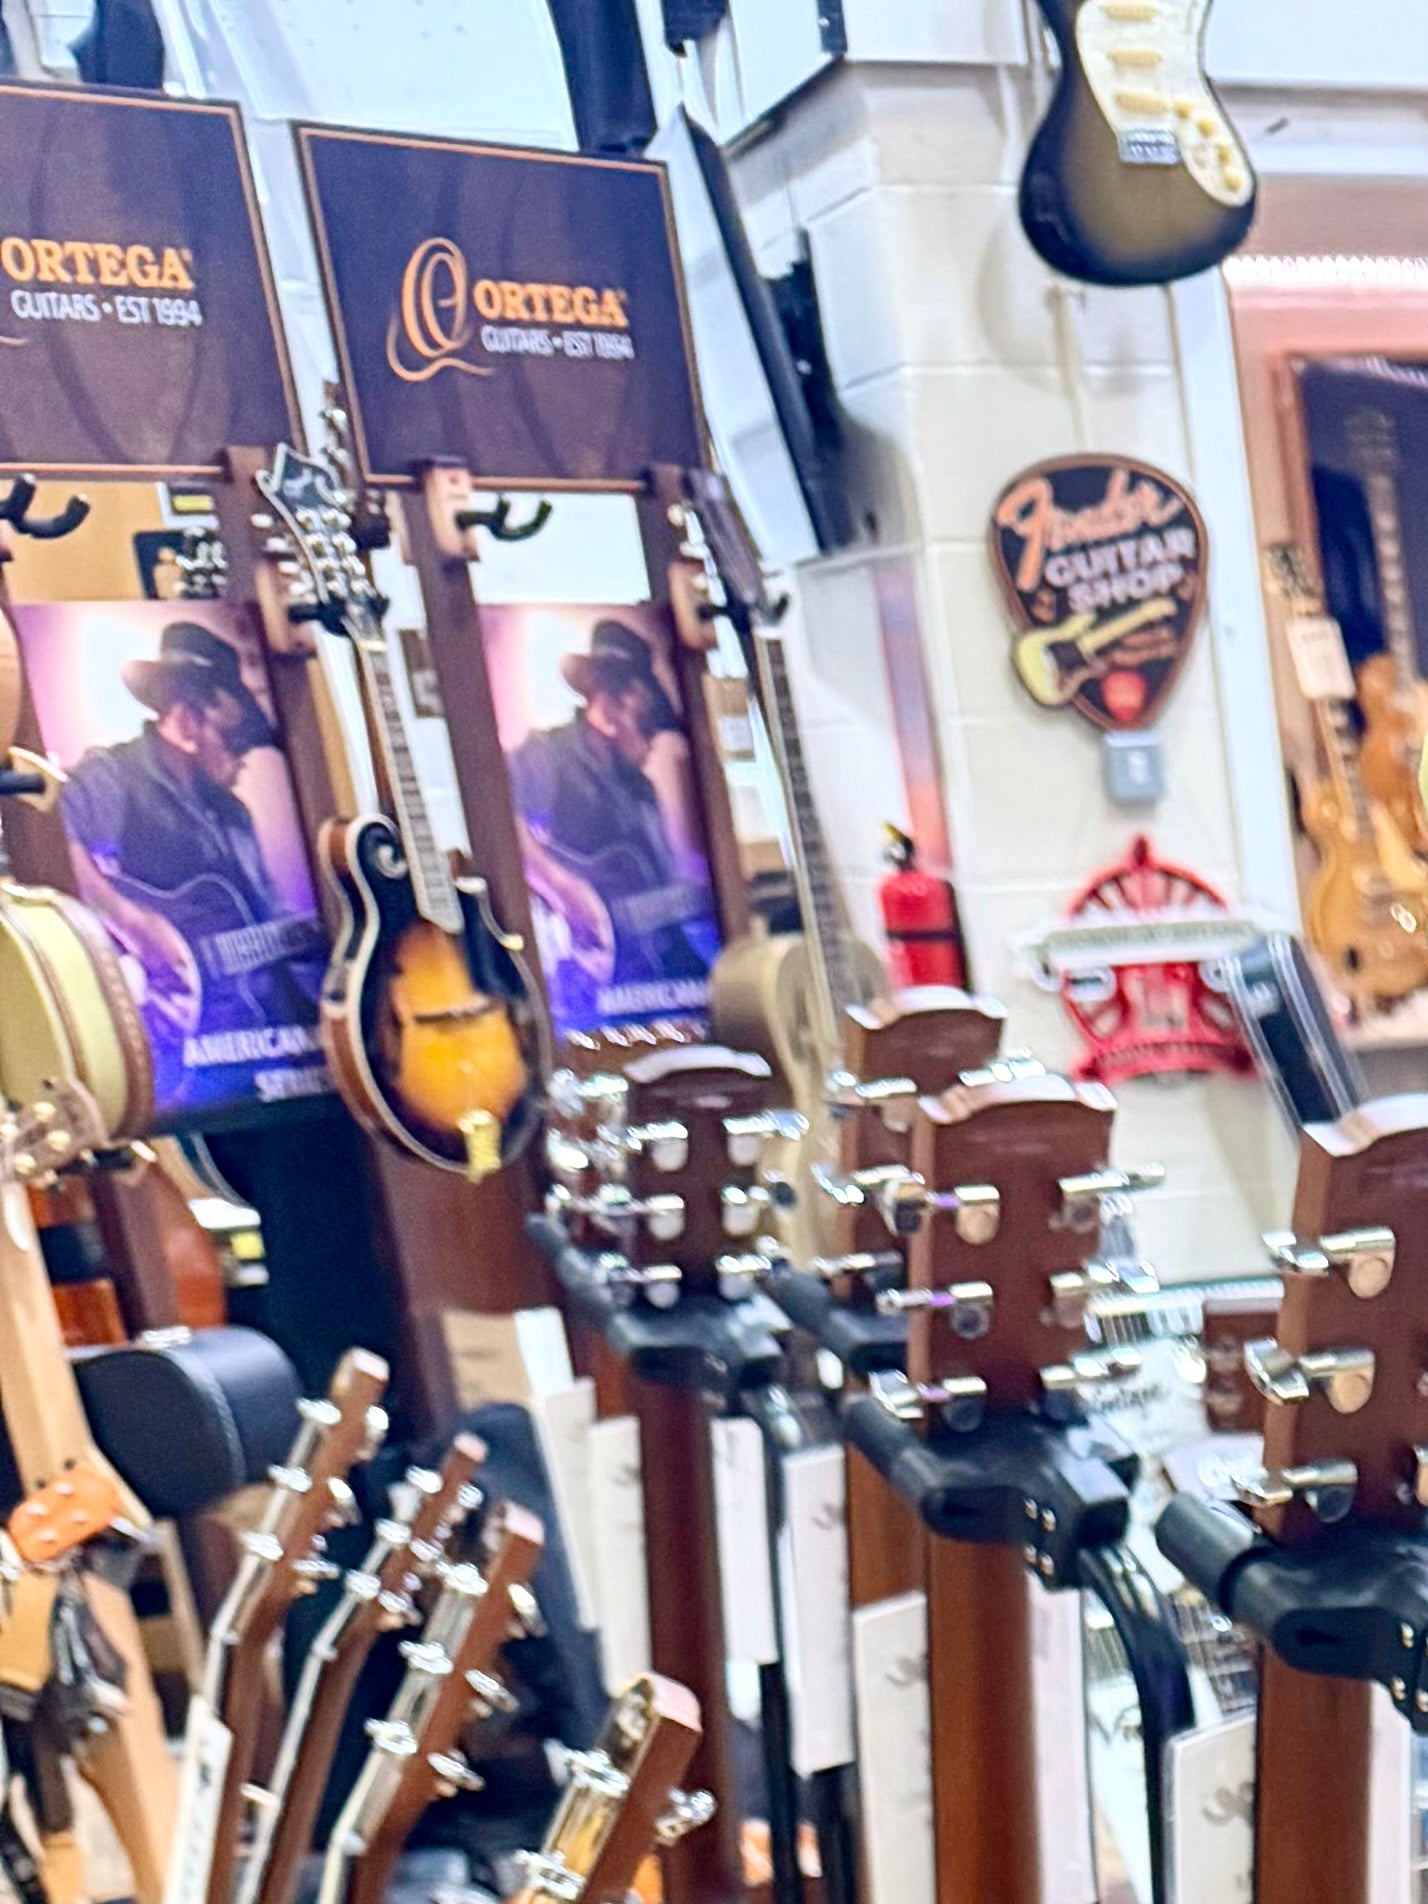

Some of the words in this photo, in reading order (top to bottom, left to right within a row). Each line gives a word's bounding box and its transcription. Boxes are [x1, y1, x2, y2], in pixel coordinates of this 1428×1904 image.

[0, 236, 195, 290] ORTEGA
[11, 289, 101, 322] GUITARS
[114, 295, 149, 325] EST
[473, 278, 629, 328] ORTEGA
[1045, 527, 1196, 588] GUITAR
[1068, 561, 1185, 612] SHOP
[183, 1025, 322, 1068] AMERICAN
